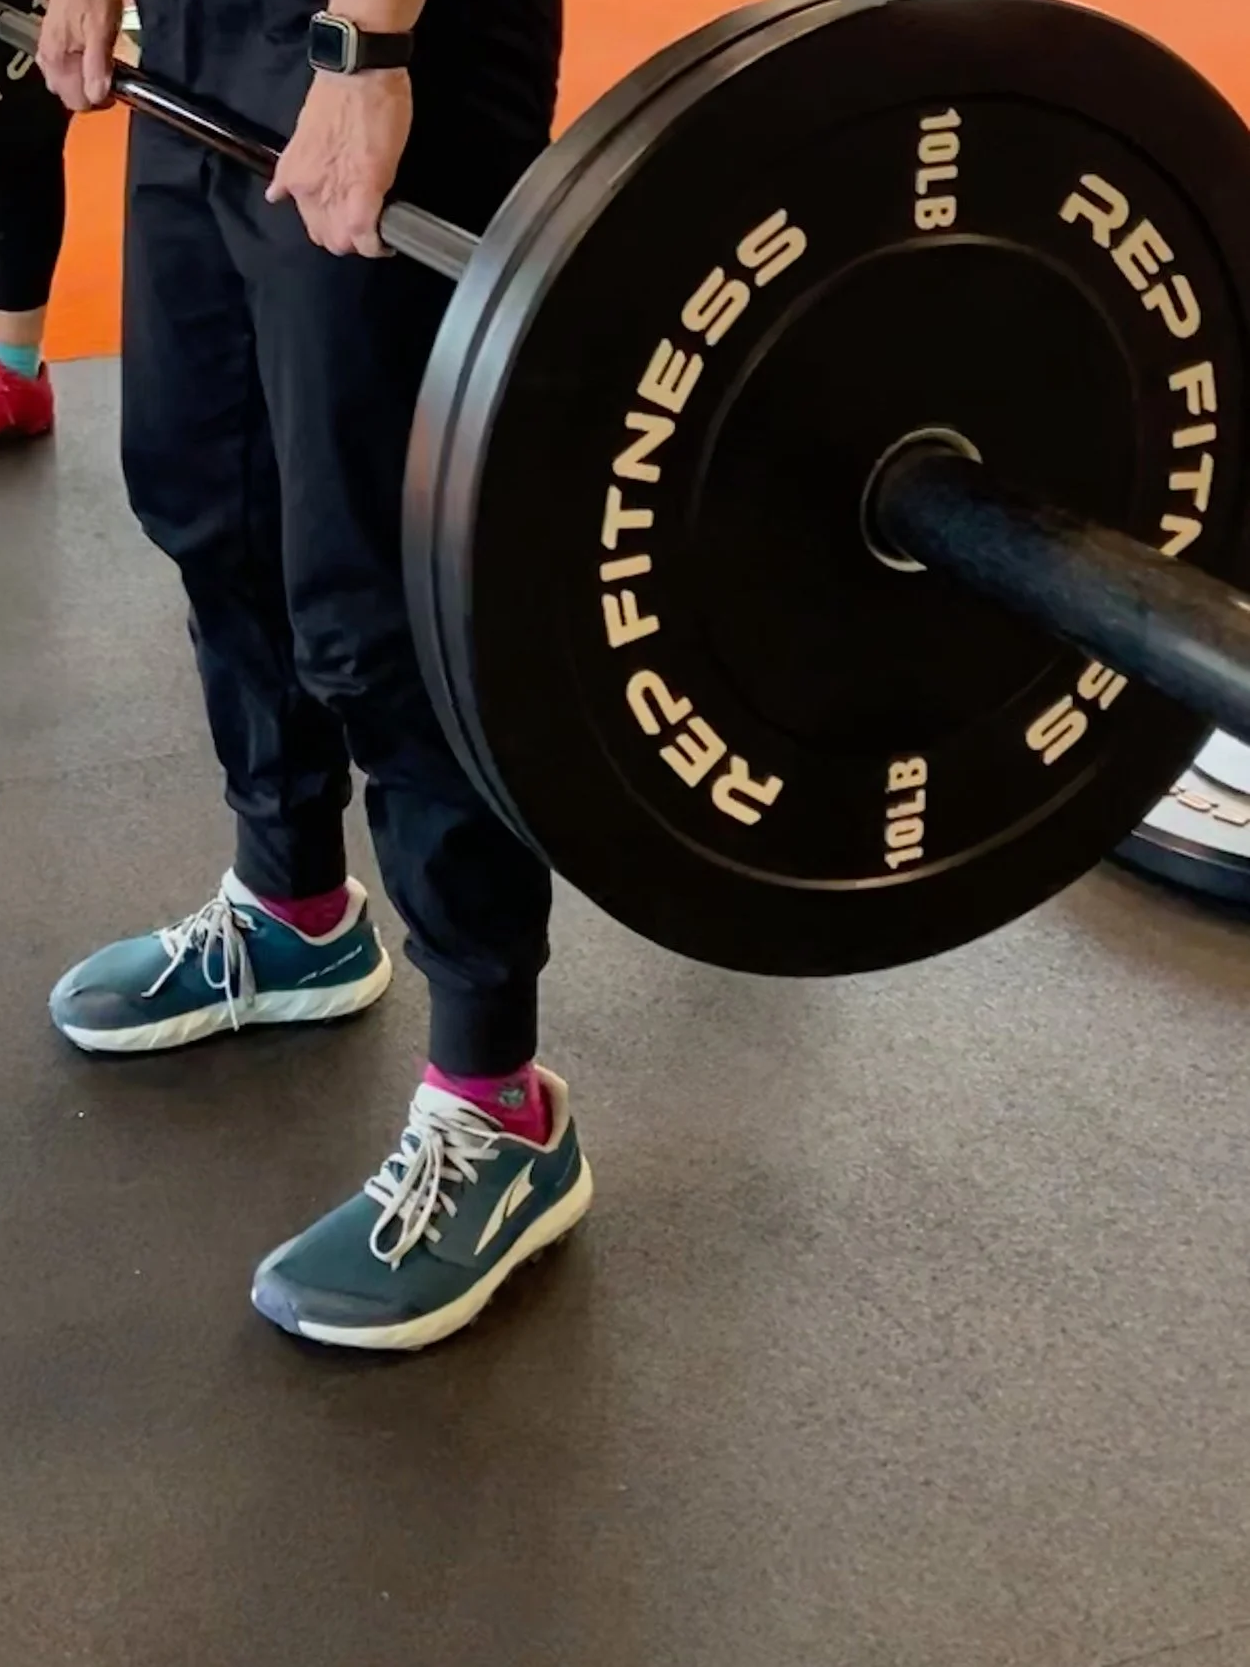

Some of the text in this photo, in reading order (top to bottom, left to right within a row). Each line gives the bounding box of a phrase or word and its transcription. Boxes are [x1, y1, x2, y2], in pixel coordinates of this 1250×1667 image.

[915, 107, 962, 230] 10LB
[1058, 173, 1202, 339] REP
[600, 207, 807, 825] REP FITNESS
[884, 756, 928, 869] 10LB
